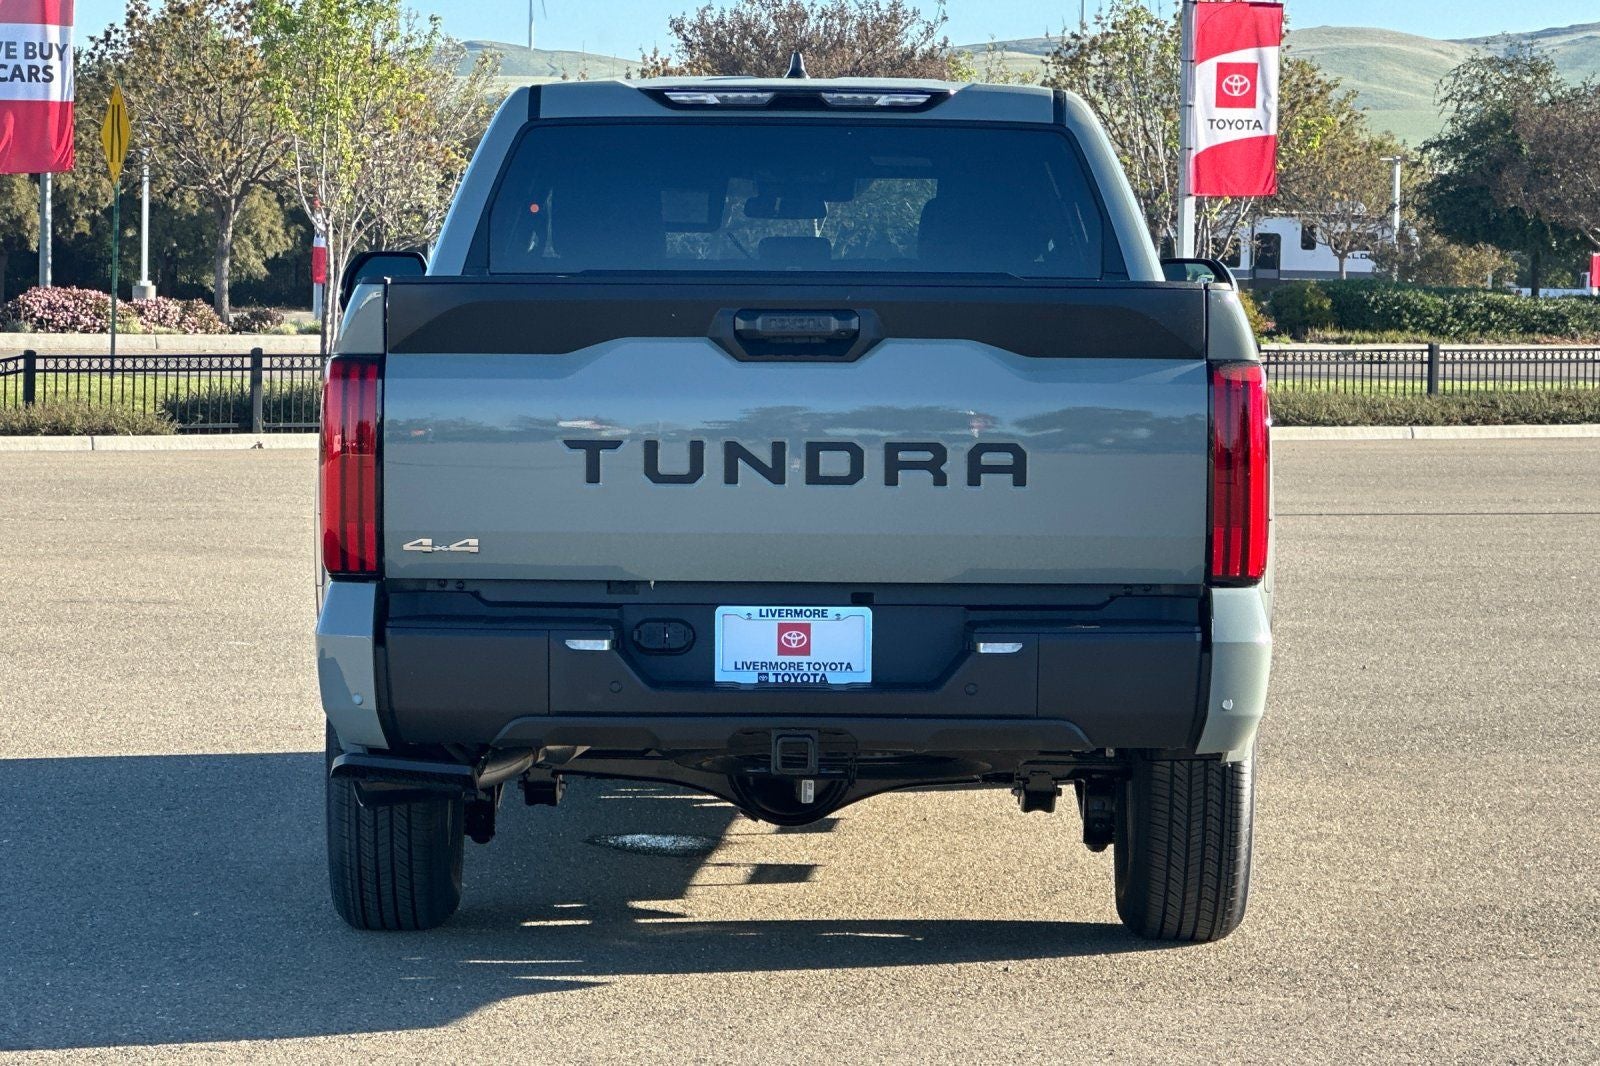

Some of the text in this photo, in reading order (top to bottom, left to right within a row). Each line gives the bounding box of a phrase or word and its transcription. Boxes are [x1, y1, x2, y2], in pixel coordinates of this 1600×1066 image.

[0, 41, 68, 61] E BUY
[1207, 118, 1263, 130] TOYOTA
[562, 439, 1027, 487] TUNDRA
[402, 538, 479, 553] 4x4
[759, 608, 828, 618] LIVERMORE
[734, 661, 853, 671] LIVERMORE TOYOTA
[772, 672, 828, 683] TOYOTA
